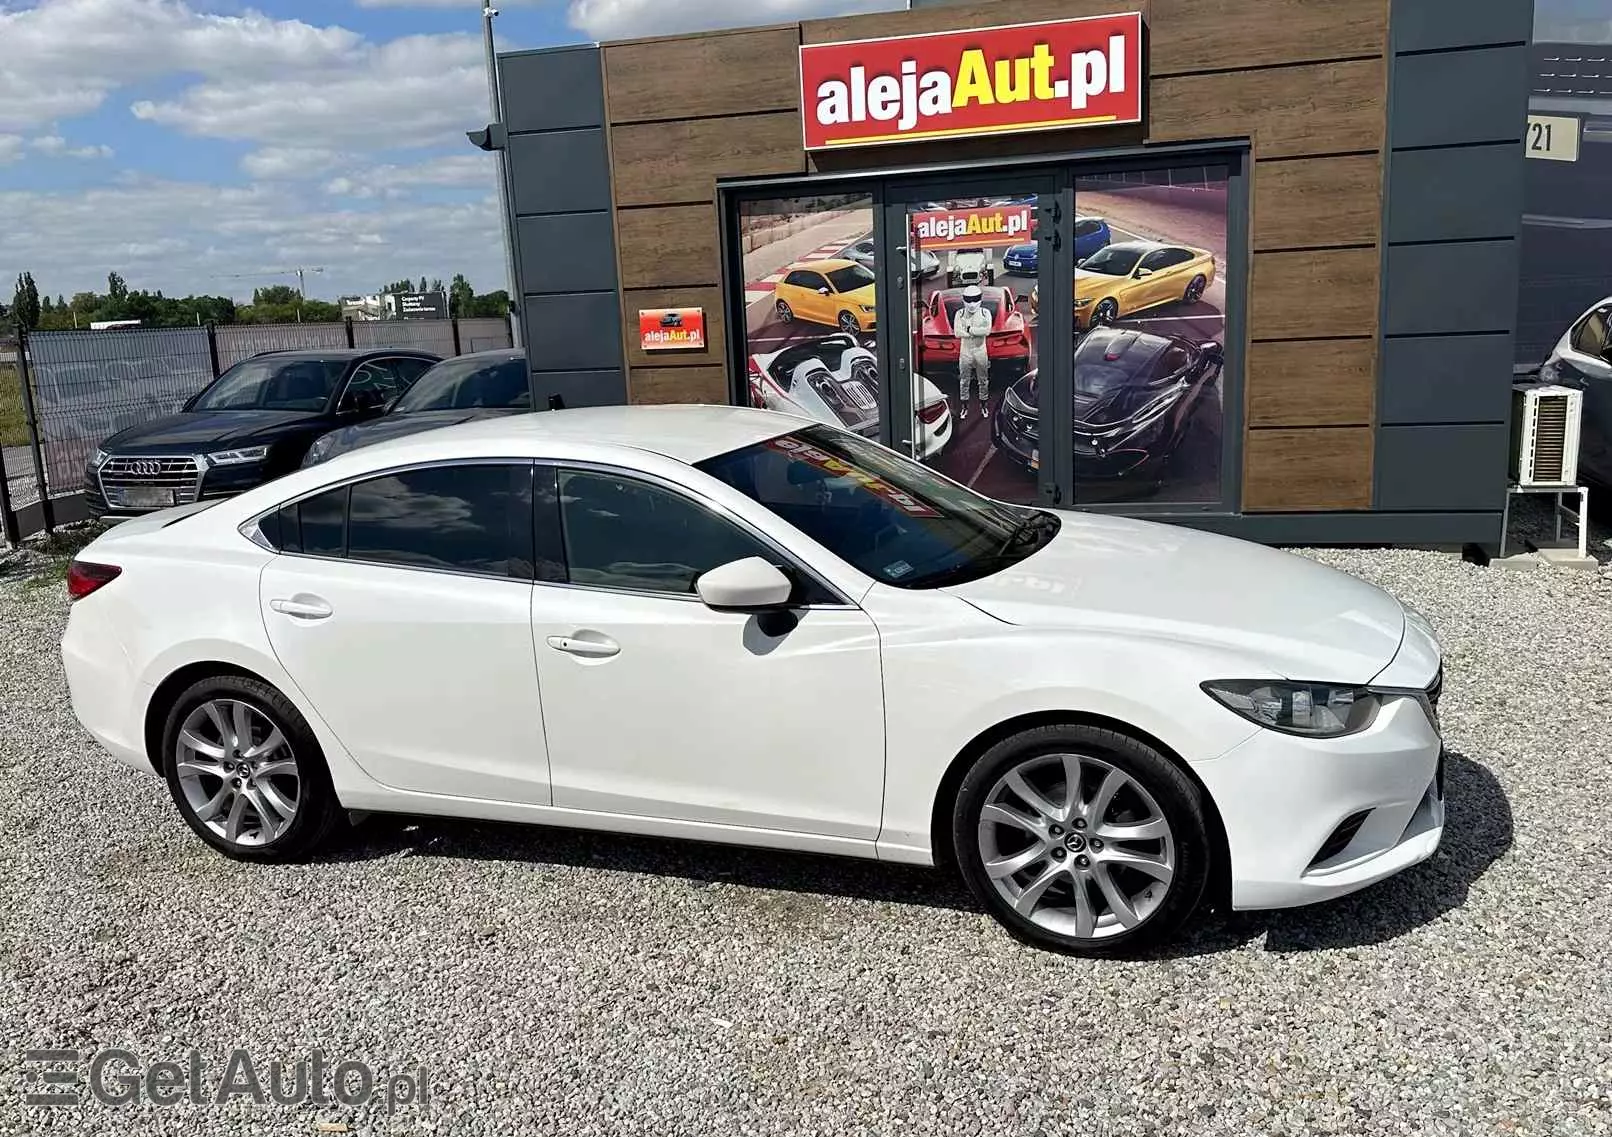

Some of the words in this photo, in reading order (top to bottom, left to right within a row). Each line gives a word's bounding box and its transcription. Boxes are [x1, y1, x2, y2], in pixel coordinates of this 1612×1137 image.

[817, 35, 1126, 131] alejaAut.pl
[918, 210, 1028, 240] alejaAut.pl
[644, 329, 701, 342] alejaAut.pl
